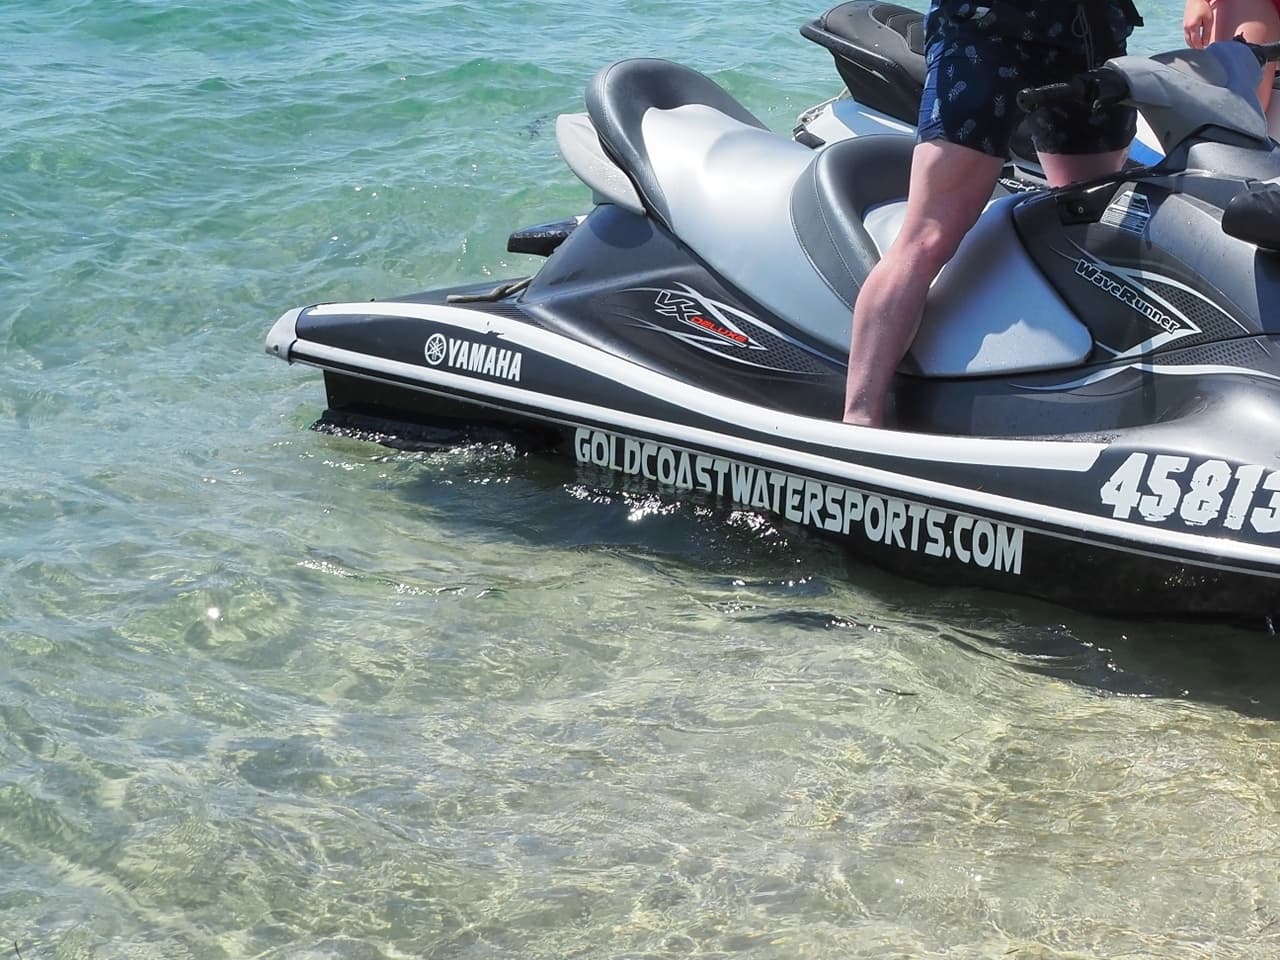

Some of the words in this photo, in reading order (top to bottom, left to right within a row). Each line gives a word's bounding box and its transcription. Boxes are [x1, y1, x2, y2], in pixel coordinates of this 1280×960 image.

[1075, 259, 1180, 333] WaveRunner
[447, 338, 521, 382] YAMAHA
[574, 427, 1024, 574] GOLDCOASTWATERSPORTS.COM
